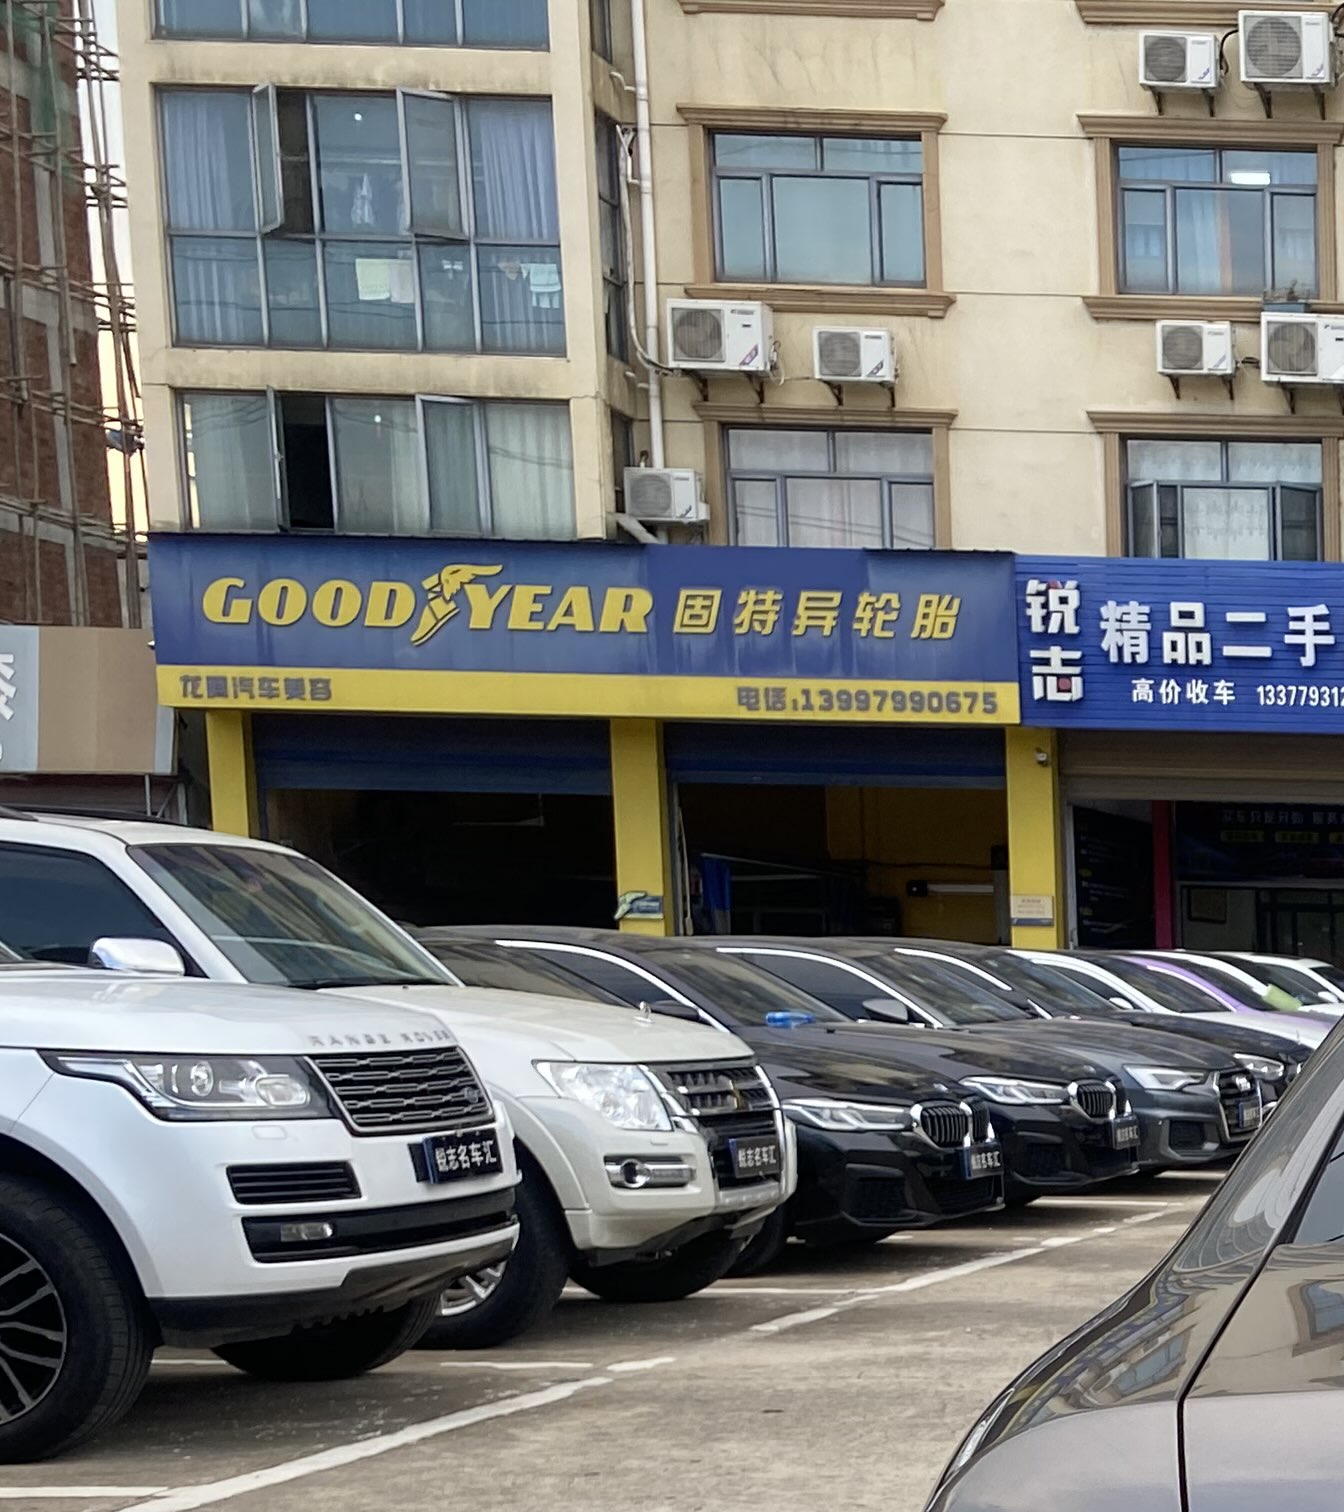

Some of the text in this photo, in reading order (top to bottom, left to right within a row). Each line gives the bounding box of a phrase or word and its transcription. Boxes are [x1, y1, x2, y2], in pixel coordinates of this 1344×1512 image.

[202, 576, 654, 634] GOODYEAR
[673, 588, 961, 640] 固特异轮胎
[1026, 579, 1082, 702] 锐志
[1131, 678, 1236, 705] 高价收车
